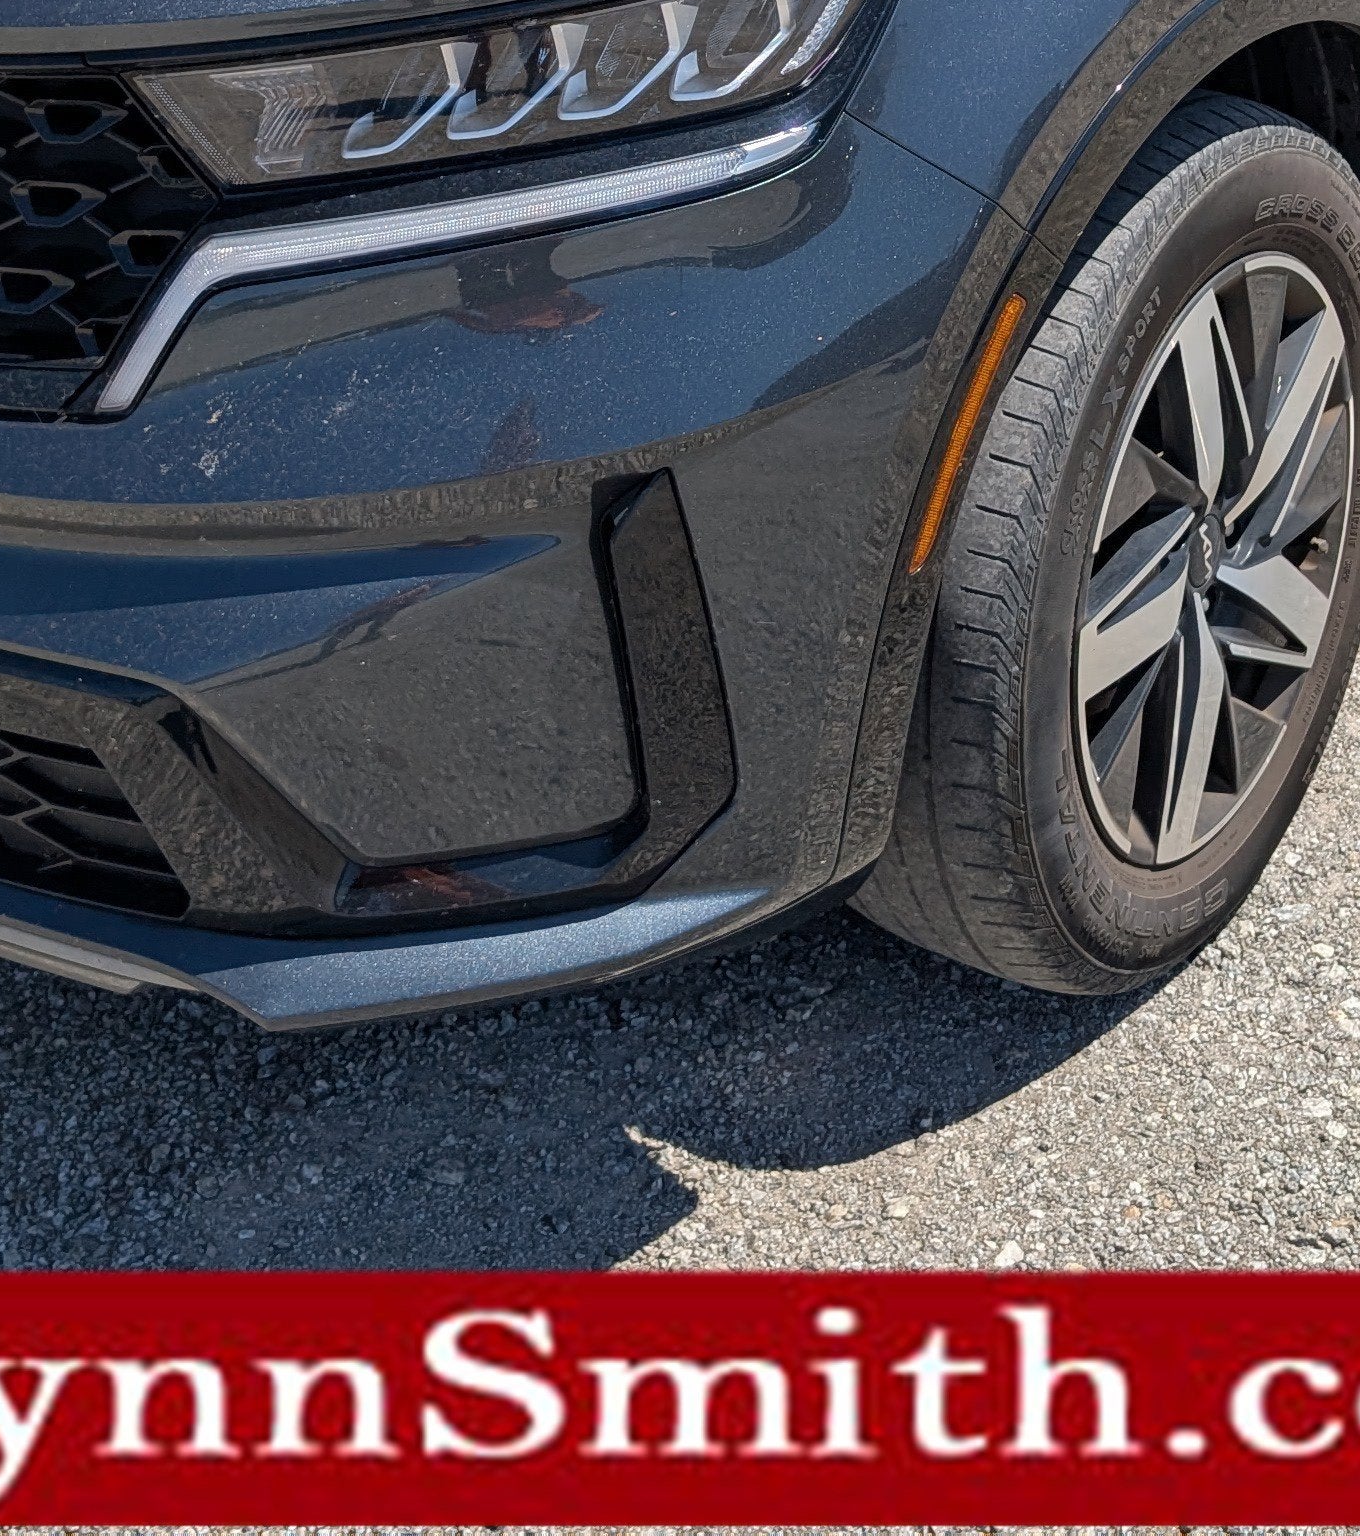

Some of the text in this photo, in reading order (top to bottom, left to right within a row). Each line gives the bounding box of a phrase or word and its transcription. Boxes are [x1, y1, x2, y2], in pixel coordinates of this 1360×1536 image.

[1255, 193, 1340, 234] CROSS
[1089, 375, 1126, 451] LX
[1116, 285, 1162, 376] SPORT
[1054, 748, 1230, 940] CONTINENTAL
